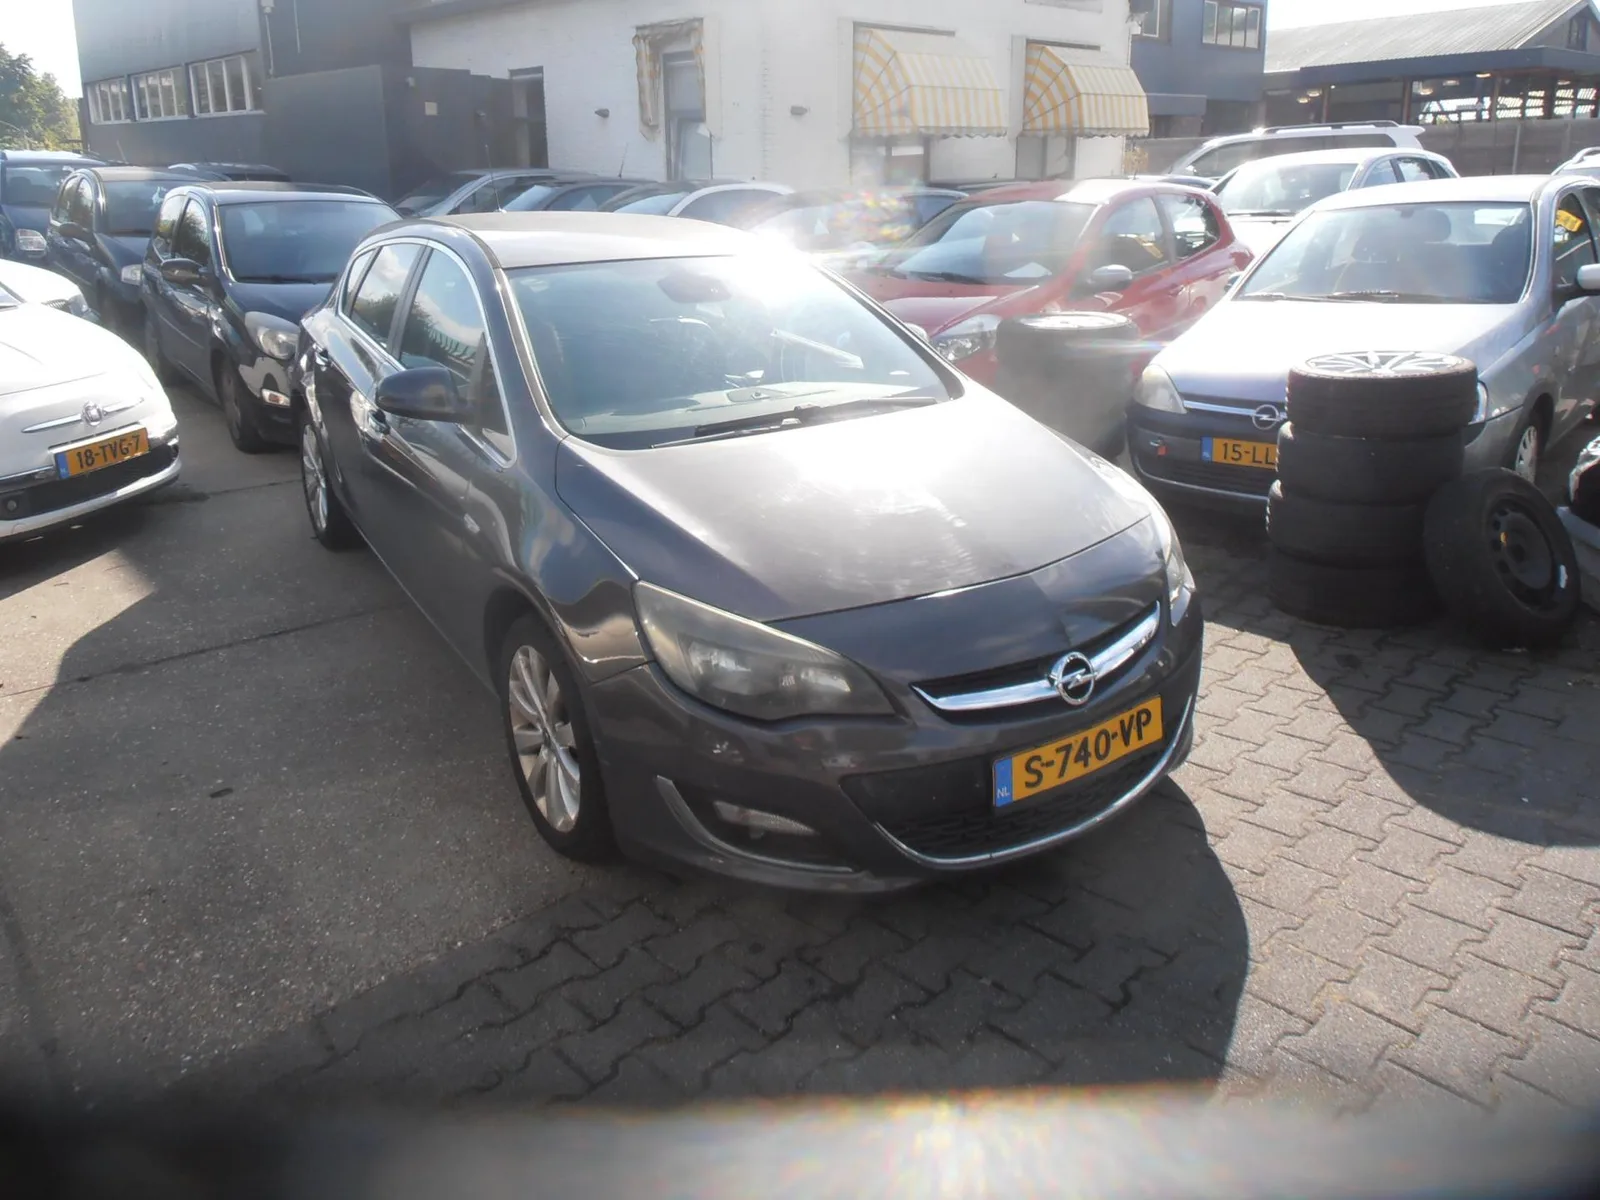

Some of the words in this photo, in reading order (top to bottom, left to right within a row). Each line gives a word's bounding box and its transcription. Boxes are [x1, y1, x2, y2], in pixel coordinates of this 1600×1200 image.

[75, 434, 141, 470] 18-TVG-7
[1024, 708, 1152, 789] S-740-VP
[996, 785, 1011, 799] NL
